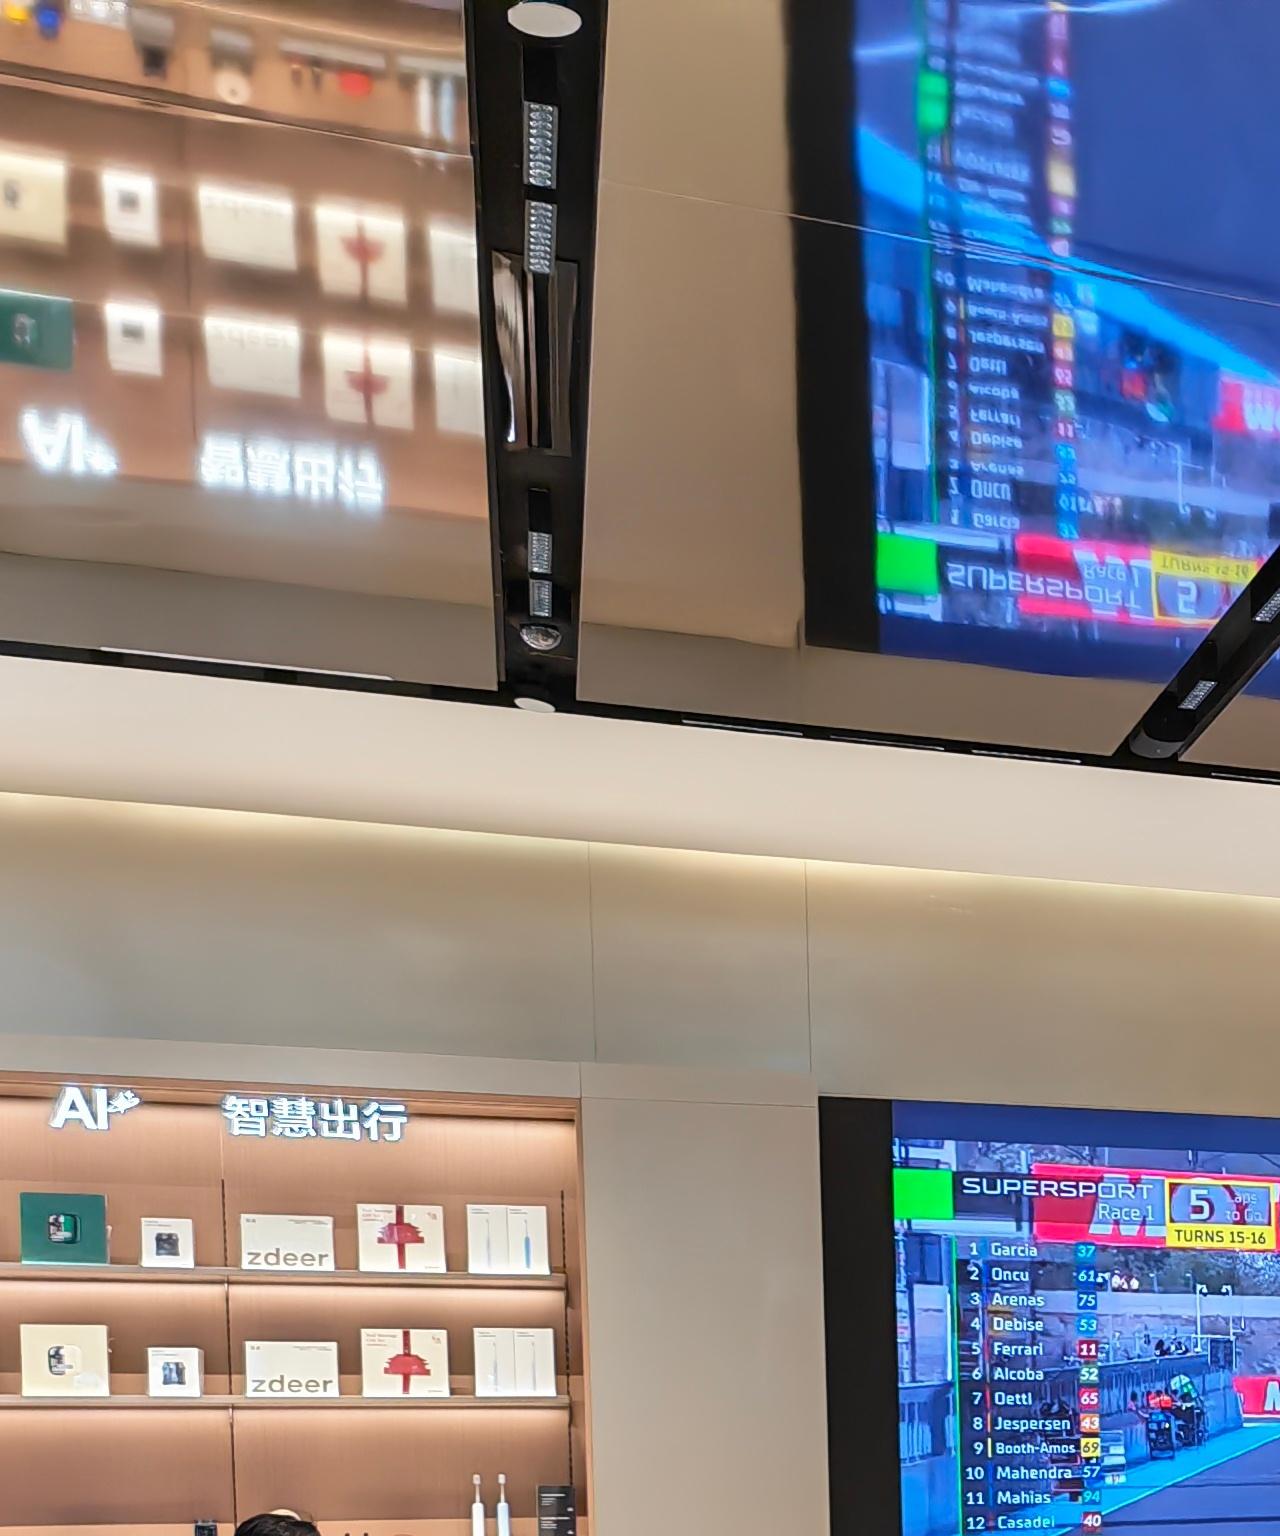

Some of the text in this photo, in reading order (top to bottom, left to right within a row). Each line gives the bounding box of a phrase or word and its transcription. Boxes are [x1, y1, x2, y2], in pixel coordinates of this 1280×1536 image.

[49, 1086, 108, 1130] AI
[222, 1095, 408, 1141] 智慧出行
[962, 1177, 1152, 1198] SUPERSPORT
[1099, 1203, 1154, 1220] Race 1
[1189, 1189, 1211, 1221] 5
[1174, 1229, 1266, 1245] TURNS 15-16
[247, 1248, 328, 1266] zdeer
[970, 1242, 1096, 1257] 1 Garcia 37
[969, 1267, 1095, 1281] 2 Oncu 61
[970, 1293, 1095, 1306] 3 Arenas 75
[970, 1317, 1097, 1330] 4 Debise 53
[972, 1342, 1097, 1356] 5 Ferrari 11
[972, 1367, 1098, 1380] 6 Alcoba 52
[252, 1376, 333, 1394] zdeer
[972, 1392, 982, 1405] 7
[1080, 1393, 1099, 1404] 65
[973, 1417, 1099, 1432] 8 Jespersen 43
[973, 1442, 1099, 1454] 9 Booth-Amos 69
[965, 1466, 1100, 1480] 10 Mahendra 57
[966, 1490, 1100, 1504] 11 Mahias 94
[966, 1515, 1101, 1530] 12 Casadei 40
